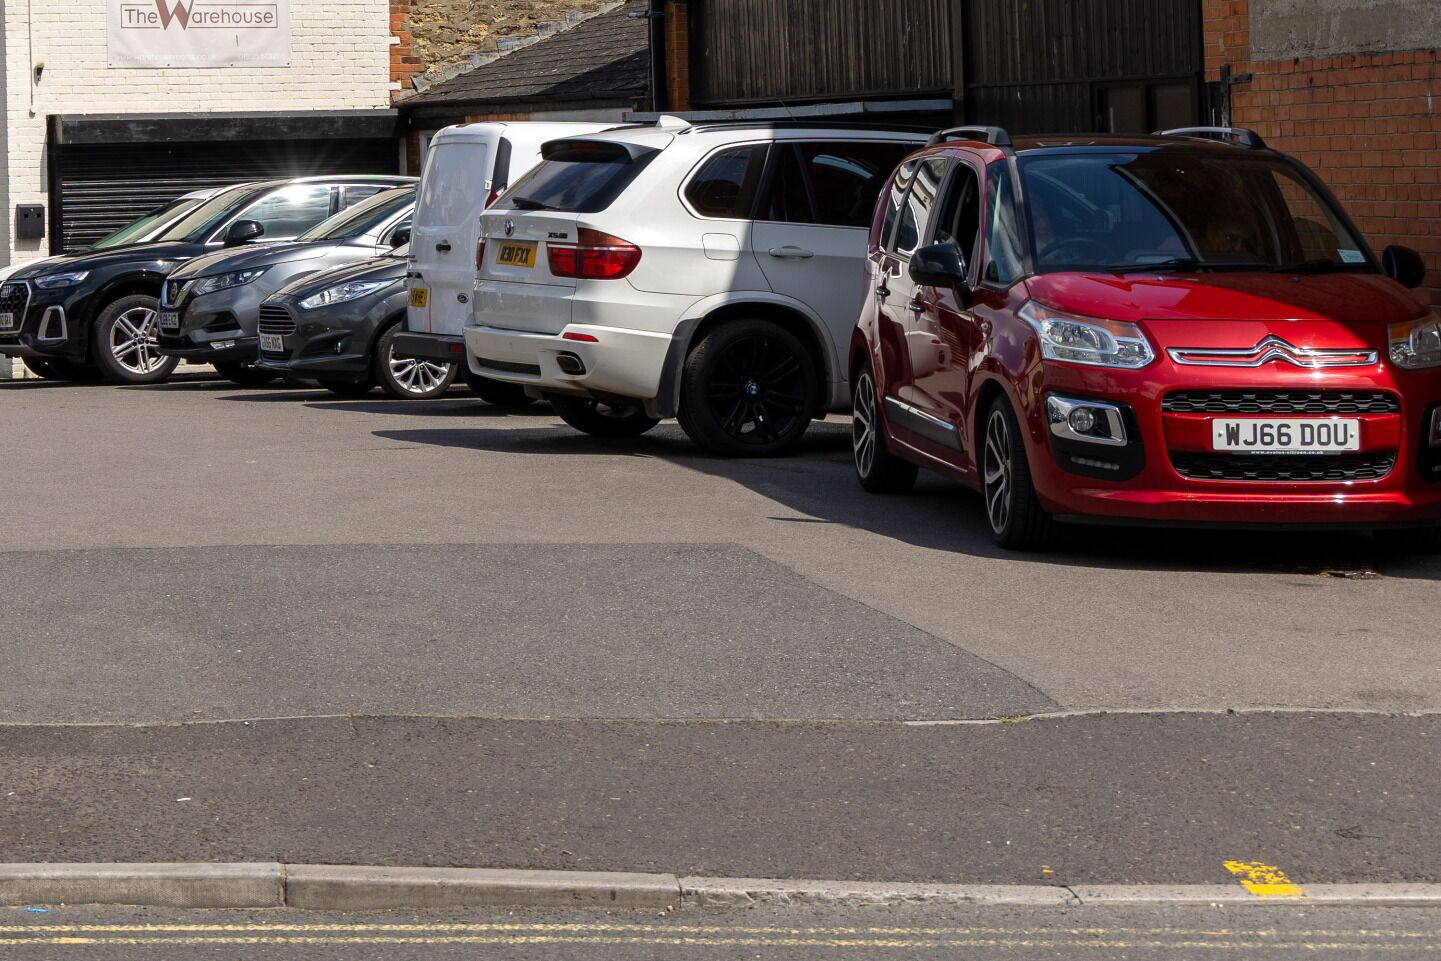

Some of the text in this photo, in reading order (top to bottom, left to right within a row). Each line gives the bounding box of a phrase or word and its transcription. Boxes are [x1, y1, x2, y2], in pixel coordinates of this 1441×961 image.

[124, 9, 158, 24] The
[514, 247, 532, 265] FXX
[1225, 423, 1348, 447] WJ66 DOU
